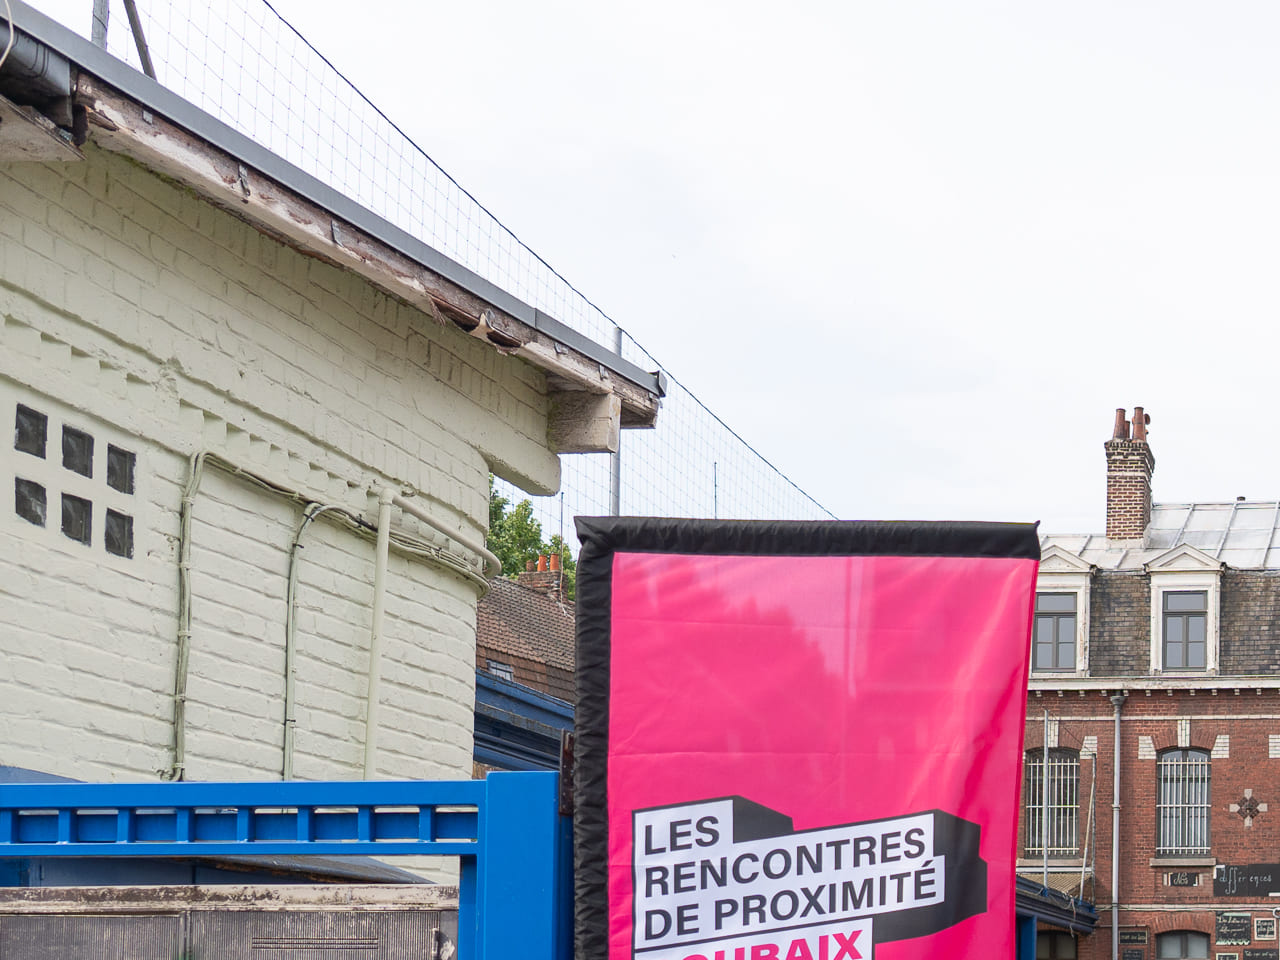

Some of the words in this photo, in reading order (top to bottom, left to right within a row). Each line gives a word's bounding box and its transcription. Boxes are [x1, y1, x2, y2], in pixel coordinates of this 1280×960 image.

[644, 815, 720, 856] LES
[645, 827, 926, 898] RENCONTRES
[645, 909, 700, 941] DE
[714, 860, 937, 931] PROXIMITÉ
